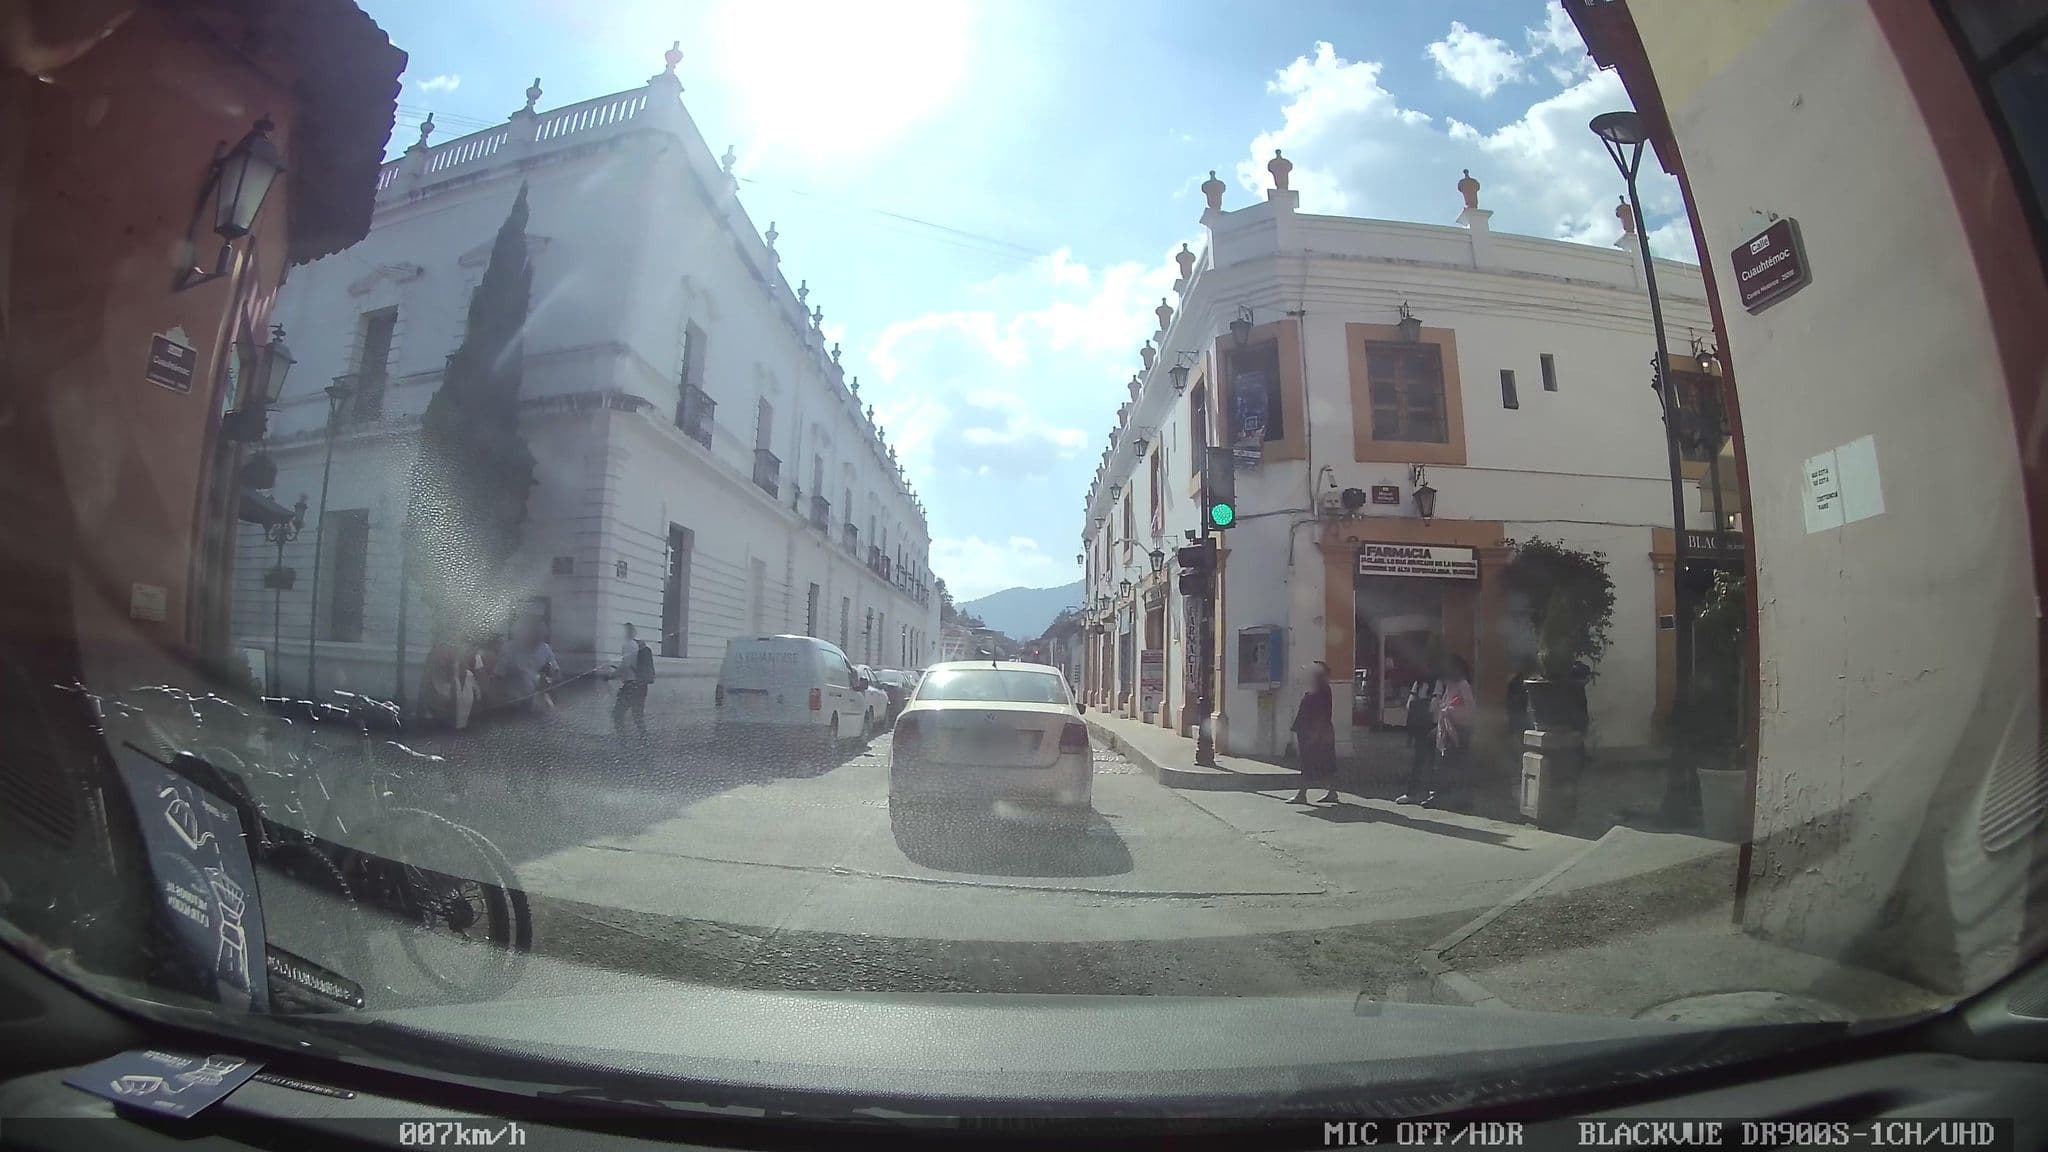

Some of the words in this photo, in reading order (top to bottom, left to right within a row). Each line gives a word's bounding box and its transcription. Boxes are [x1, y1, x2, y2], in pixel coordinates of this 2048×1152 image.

[1752, 237, 1769, 252] Calle
[1741, 249, 1790, 281] Cuauhtémoc
[1366, 546, 1432, 559] FARMACIA
